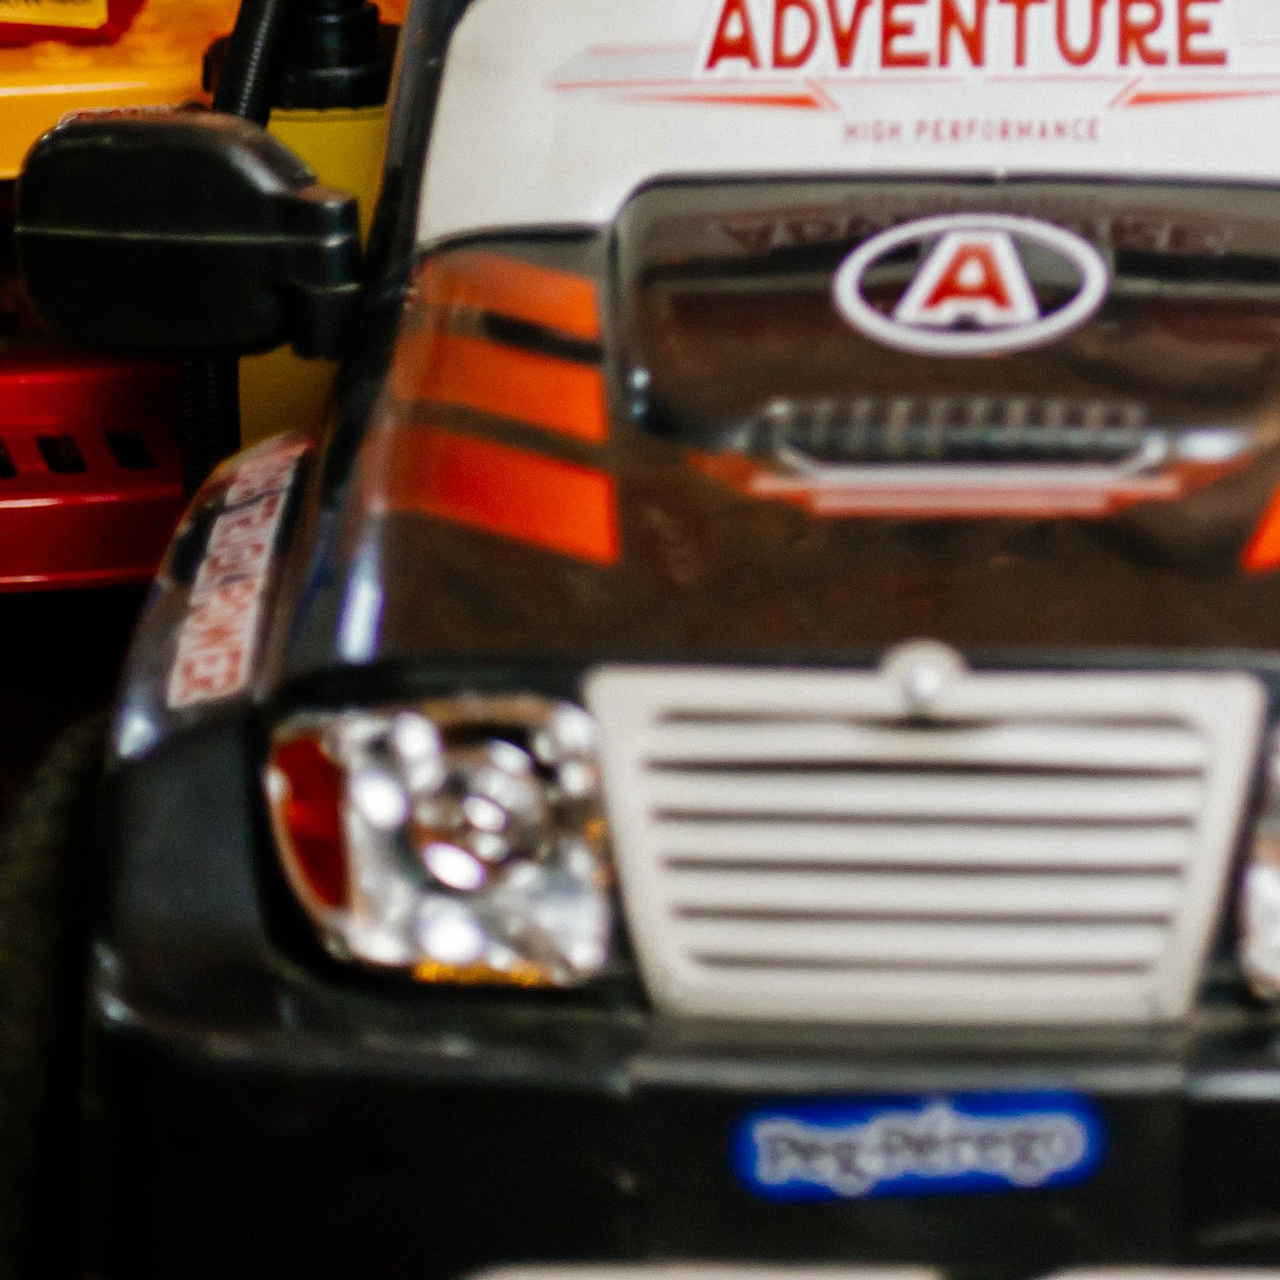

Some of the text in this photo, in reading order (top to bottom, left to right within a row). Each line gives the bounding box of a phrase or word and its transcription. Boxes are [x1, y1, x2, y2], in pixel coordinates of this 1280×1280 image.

[844, 117, 1100, 143] HIGH PERFORMANCE
[905, 236, 1028, 322] A
